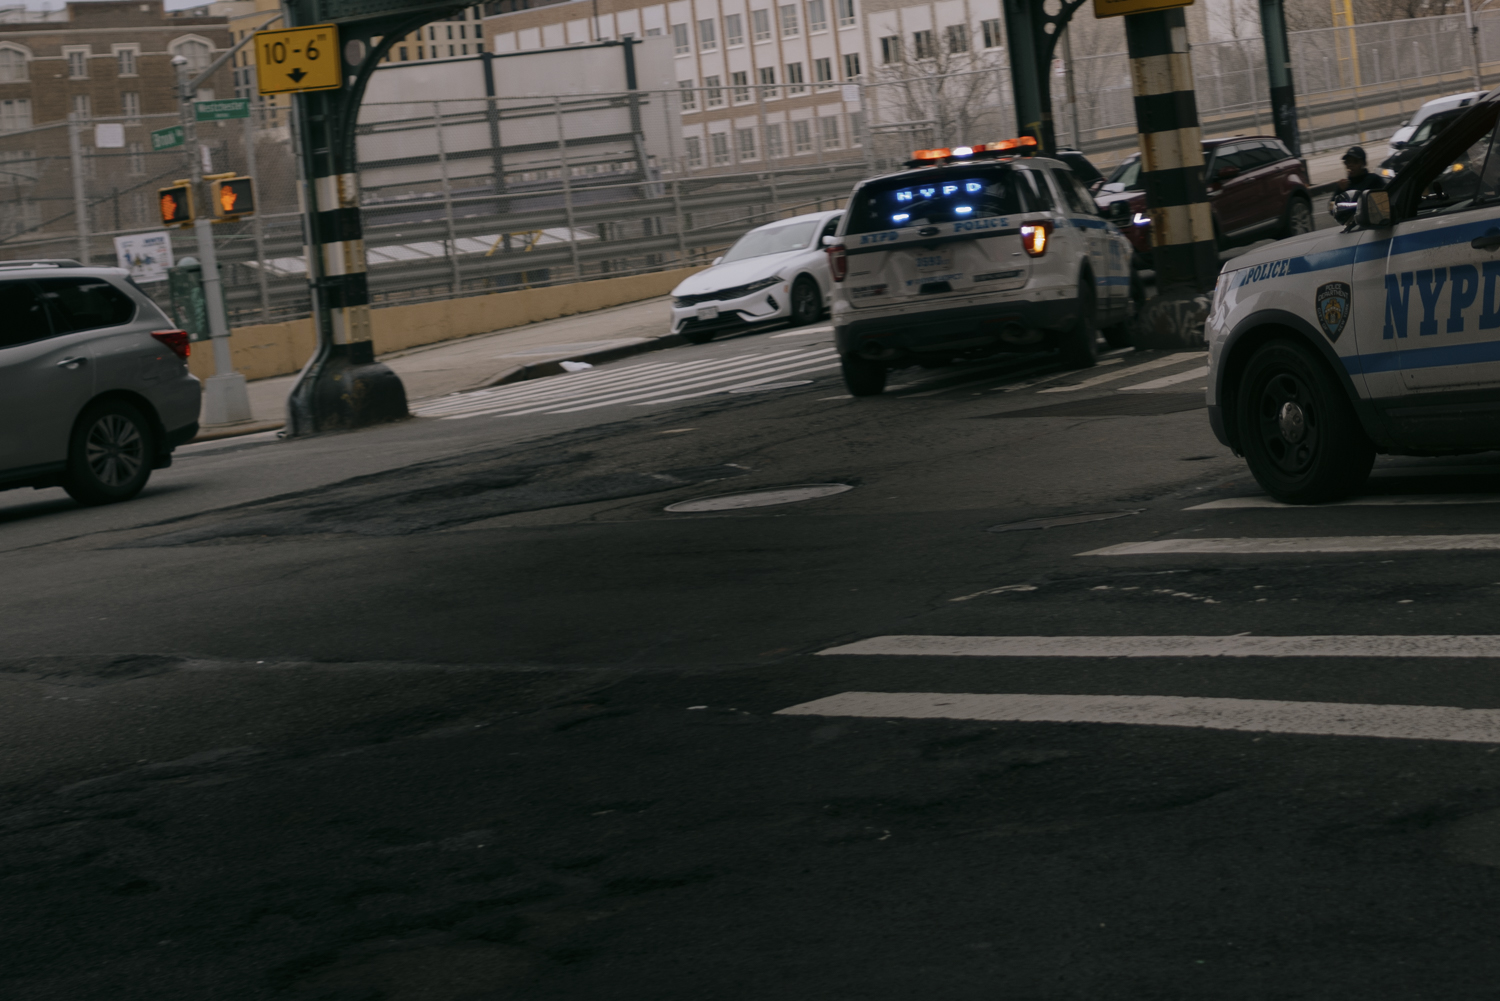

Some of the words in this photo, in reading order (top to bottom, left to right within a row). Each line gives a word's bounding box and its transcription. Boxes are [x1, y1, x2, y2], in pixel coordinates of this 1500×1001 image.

[896, 182, 982, 201] NYPD
[954, 218, 1009, 232] POLICE
[861, 231, 898, 244] NYPD
[1245, 259, 1289, 285] POLICE
[1325, 283, 1342, 291] POLICE
[1317, 289, 1349, 302] DEPARTMENT
